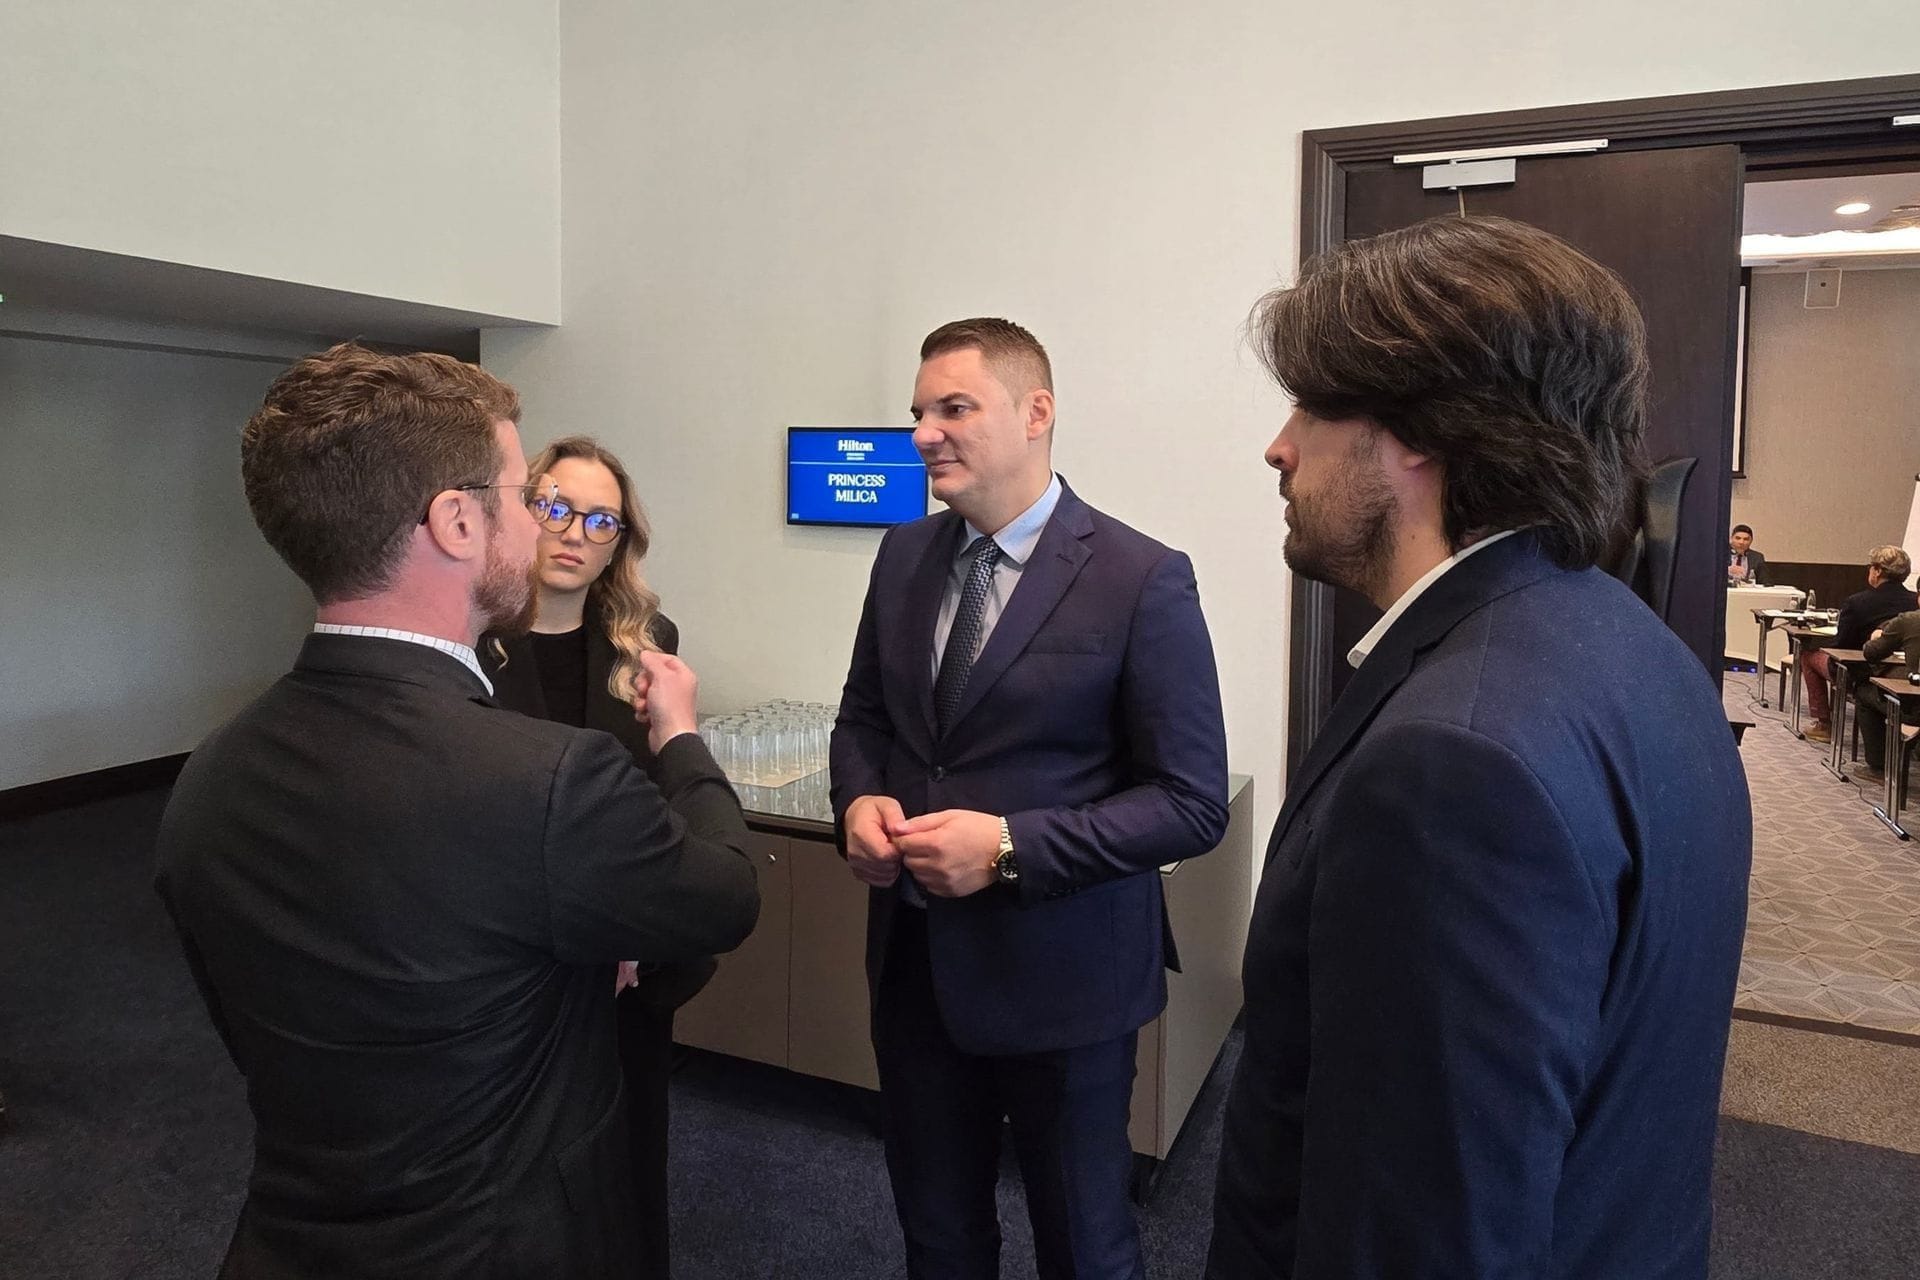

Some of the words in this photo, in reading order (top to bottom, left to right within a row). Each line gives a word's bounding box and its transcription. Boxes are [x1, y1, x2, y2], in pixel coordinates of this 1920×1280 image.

[838, 439, 874, 452] Hilton
[828, 473, 886, 487] PRINCESS
[835, 489, 878, 503] MILICA
